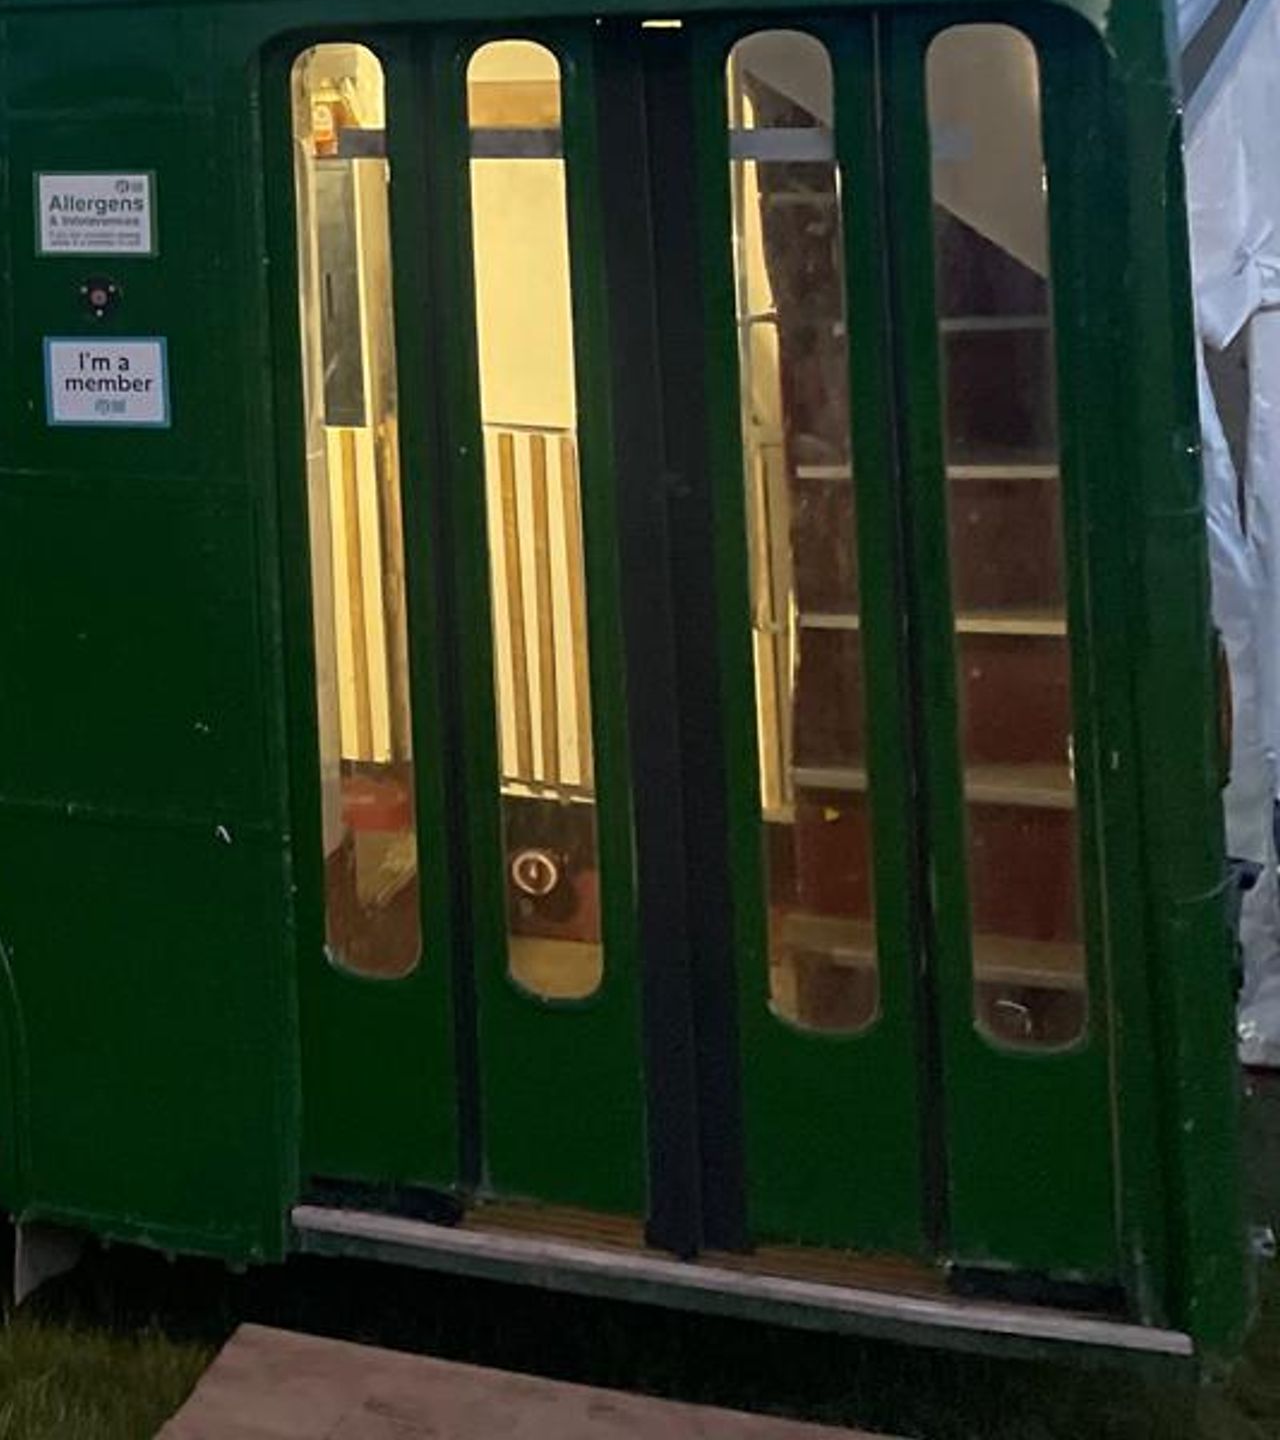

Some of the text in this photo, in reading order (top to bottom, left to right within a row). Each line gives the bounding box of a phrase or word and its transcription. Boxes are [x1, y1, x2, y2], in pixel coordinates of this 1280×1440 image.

[49, 194, 144, 216] Allergens
[79, 351, 130, 372] I'm a
[65, 374, 153, 392] member
